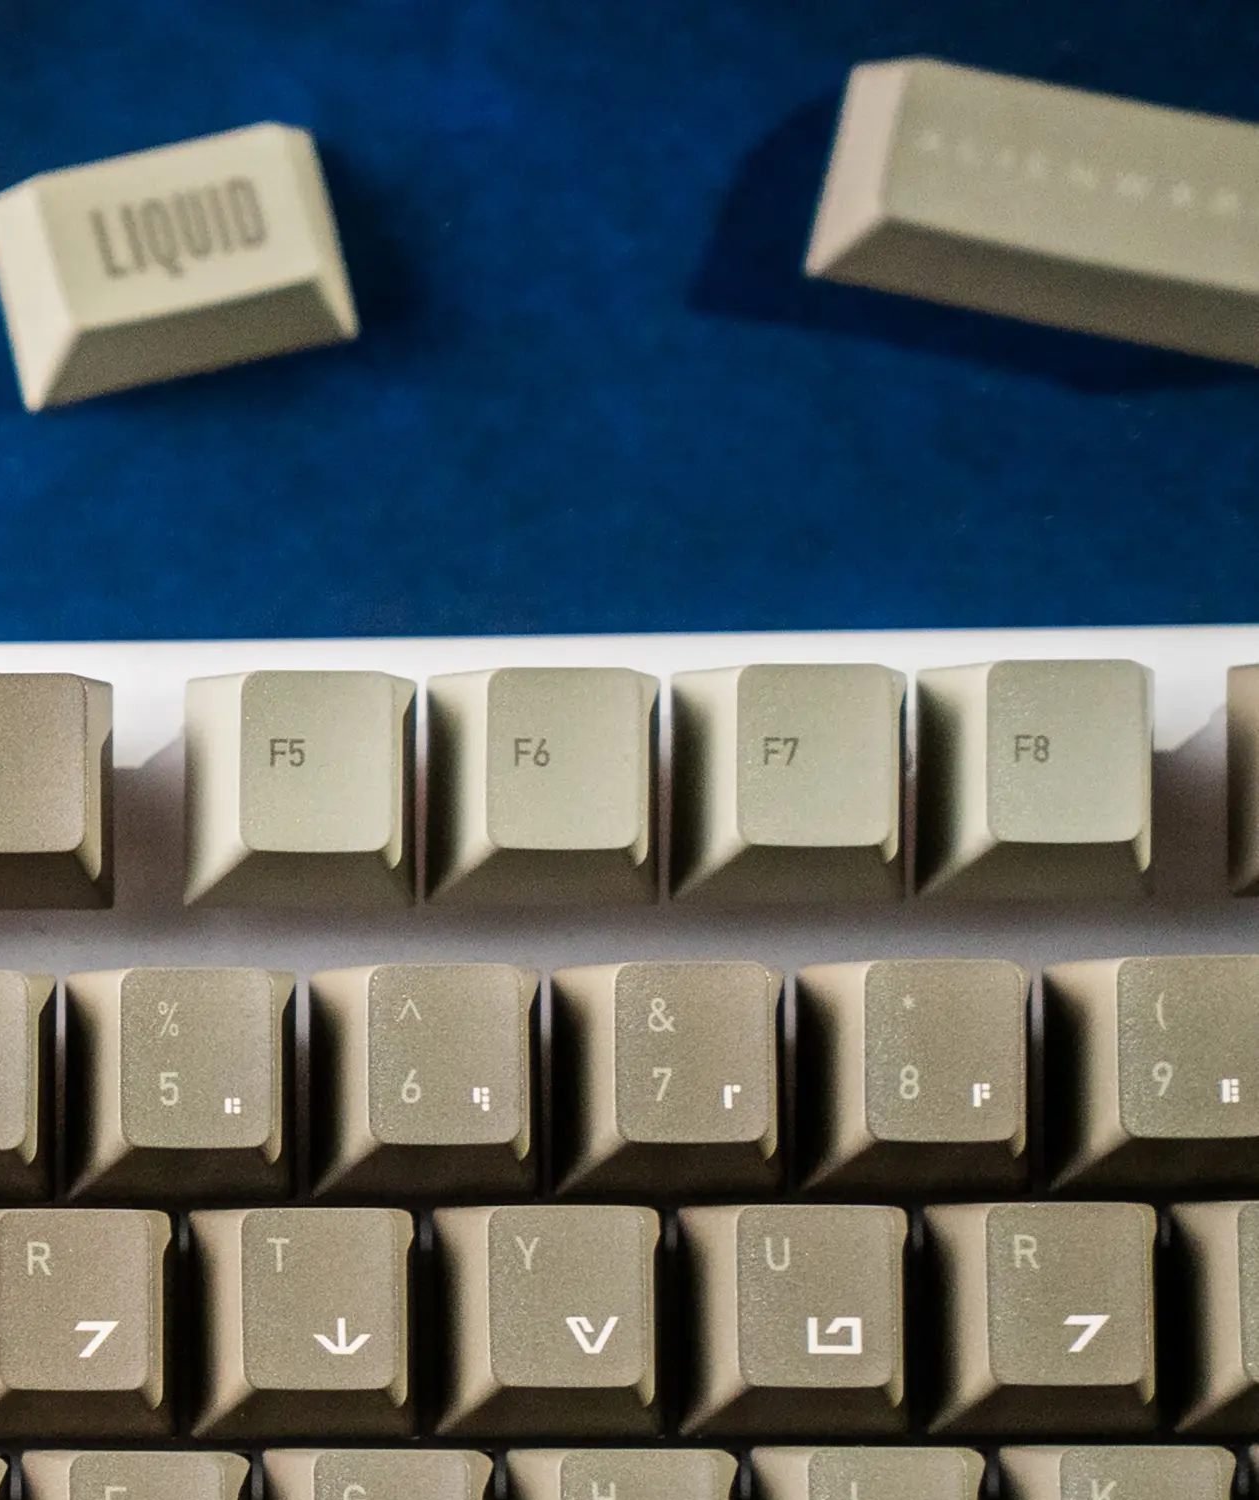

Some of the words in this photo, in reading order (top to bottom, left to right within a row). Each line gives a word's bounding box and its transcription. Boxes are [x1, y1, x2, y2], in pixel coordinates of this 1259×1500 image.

[90, 175, 268, 279] LIQUID
[269, 737, 305, 768] F5
[513, 737, 551, 768] F6
[763, 736, 800, 765] F7
[1014, 733, 1051, 763] F8
[157, 1000, 180, 1037] %
[647, 997, 675, 1032] &
[159, 1071, 180, 1106] 5
[401, 1068, 422, 1104] 6
[652, 1067, 673, 1102] 7
[899, 1064, 920, 1100] 8
[1152, 1061, 1173, 1097] 9
[27, 1241, 51, 1276] R
[267, 1237, 290, 1272] T
[515, 1236, 540, 1270] Y
[764, 1236, 791, 1272] U
[1013, 1233, 1040, 1269] R
